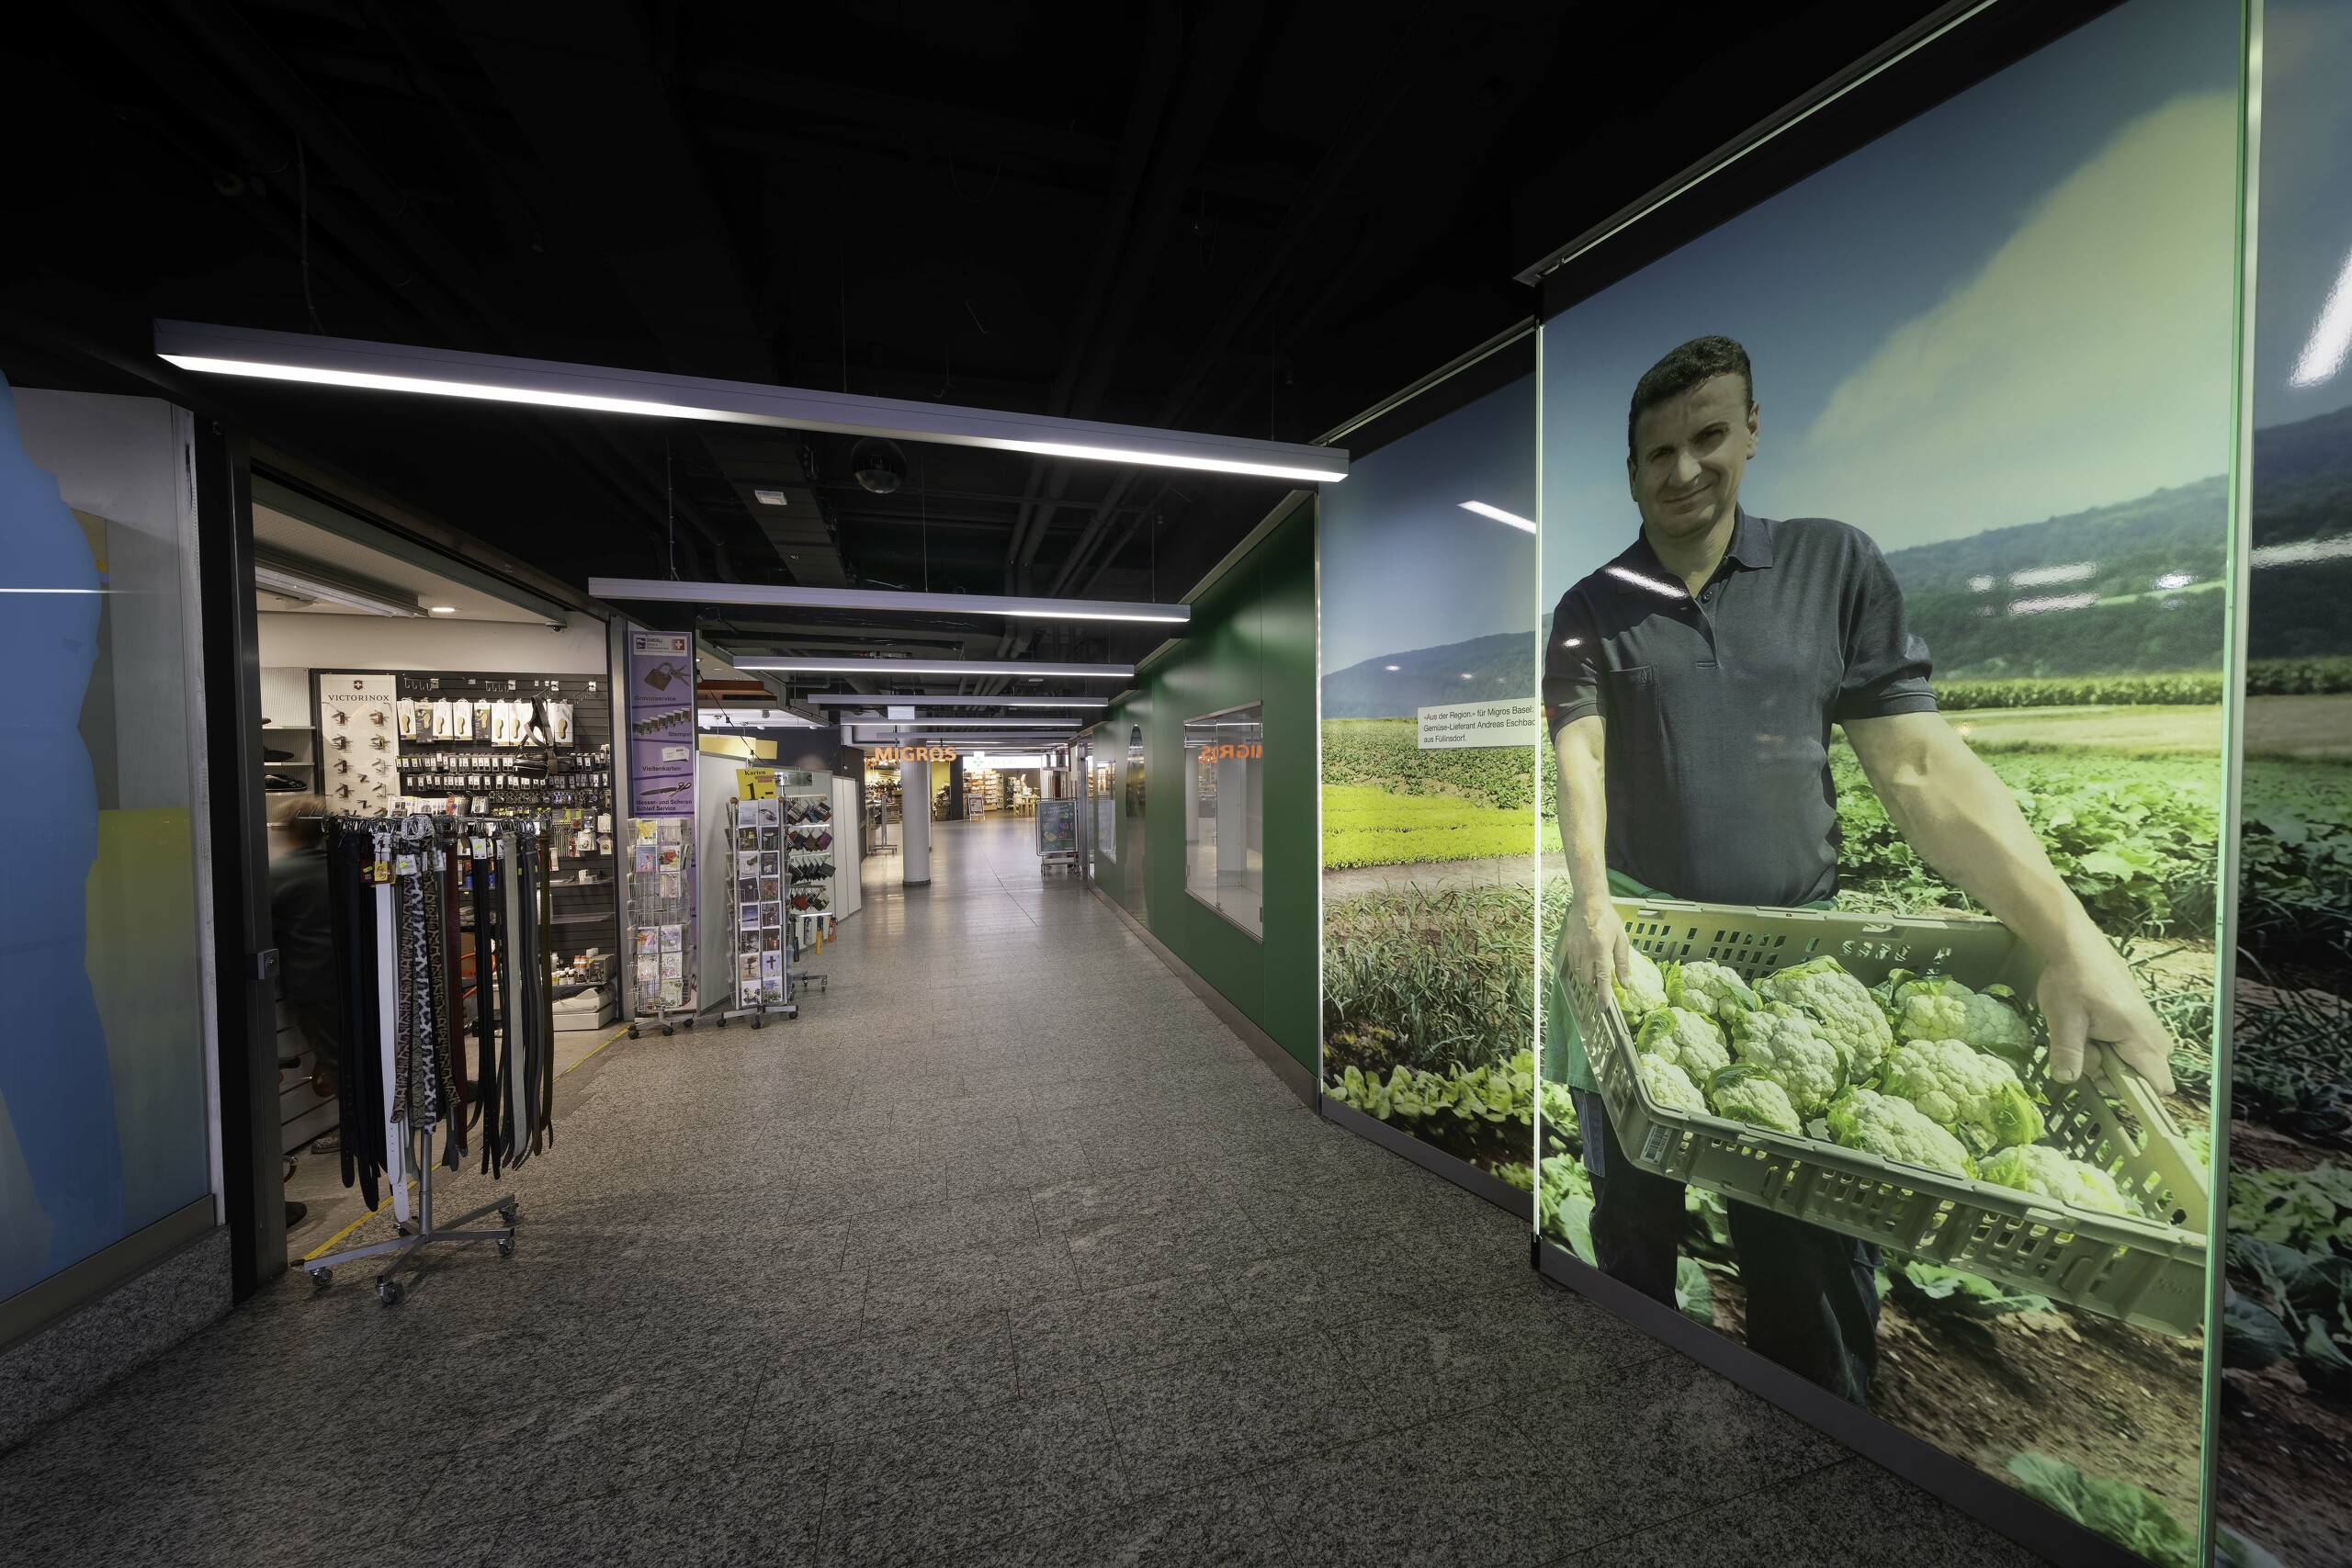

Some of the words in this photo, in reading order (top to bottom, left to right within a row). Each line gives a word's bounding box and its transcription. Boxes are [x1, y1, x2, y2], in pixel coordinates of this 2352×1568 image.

[1439, 712, 1449, 720] der
[1477, 708, 1486, 717] für
[1487, 707, 1510, 717] Migros
[1511, 705, 1534, 715] Basel:
[1423, 722, 1476, 732] Gemüse-Lieferant
[1476, 721, 1505, 729] Andreas
[875, 746, 957, 762] MIGROS
